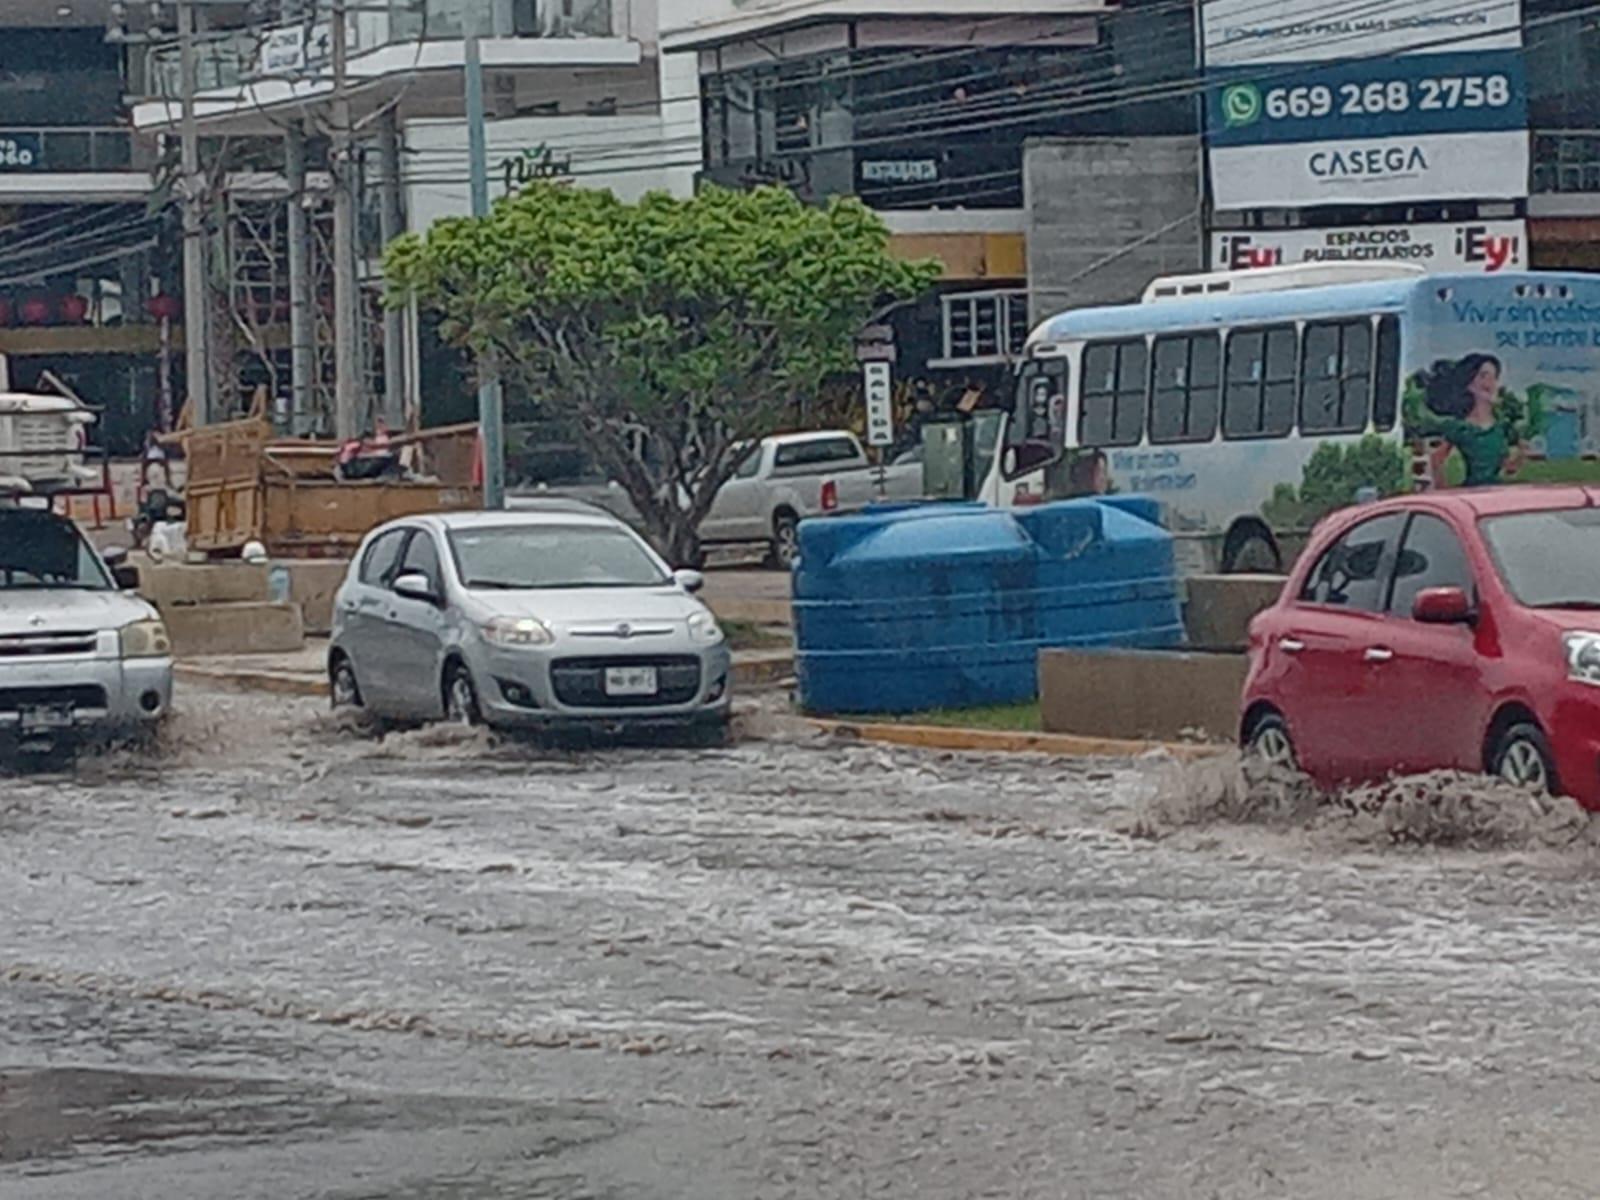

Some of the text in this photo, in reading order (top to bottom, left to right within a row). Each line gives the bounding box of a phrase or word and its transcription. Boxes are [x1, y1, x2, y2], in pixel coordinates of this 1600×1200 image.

[1266, 75, 1510, 119] 669 268 2758
[1309, 146, 1429, 176] CASEGA
[1303, 243, 1434, 262] PUBLICITARIOS
[1326, 229, 1411, 246] ESPACIOS
[1455, 226, 1519, 272] ¡Ey!
